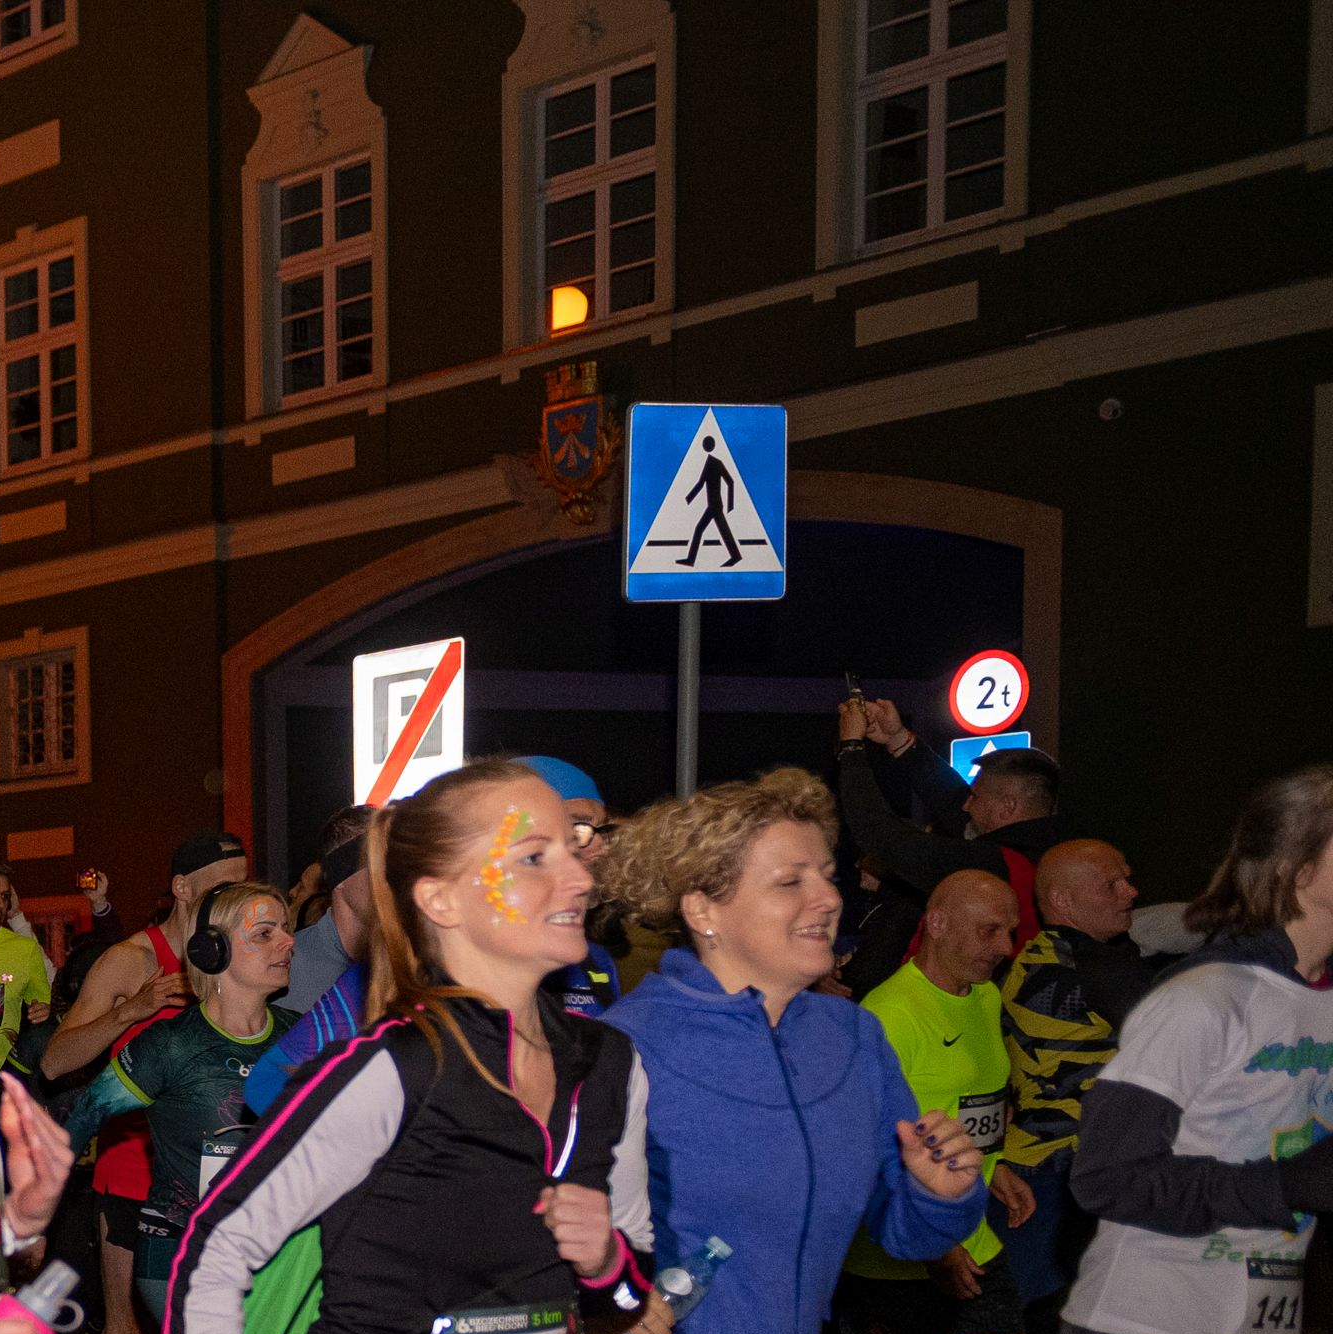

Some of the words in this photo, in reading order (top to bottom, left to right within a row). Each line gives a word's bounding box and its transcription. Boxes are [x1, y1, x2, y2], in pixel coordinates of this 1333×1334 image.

[976, 676, 996, 709] 2
[1001, 684, 1010, 707] t
[965, 1111, 1000, 1137] 285
[532, 1312, 541, 1327] 5
[542, 1310, 562, 1325] km
